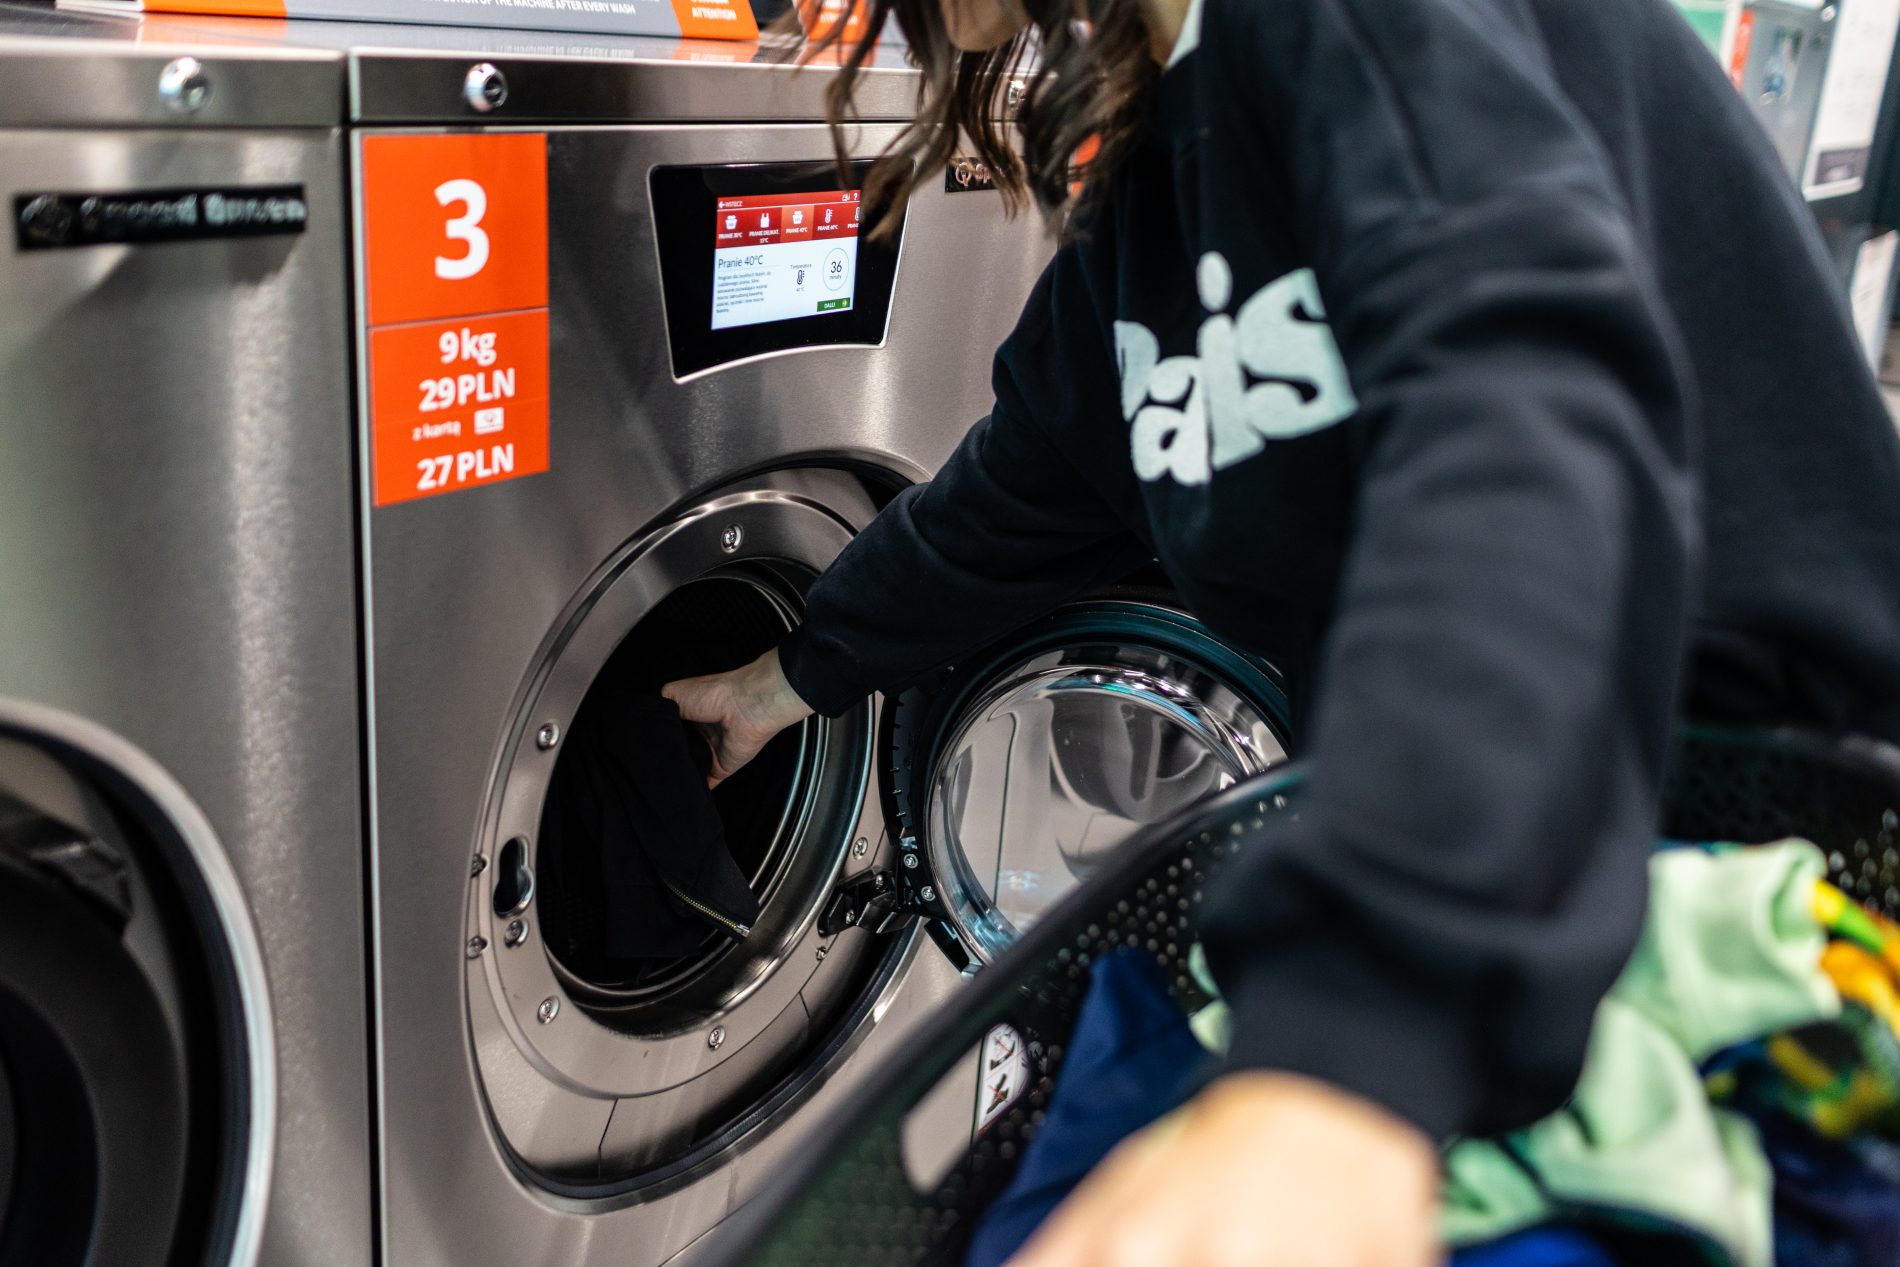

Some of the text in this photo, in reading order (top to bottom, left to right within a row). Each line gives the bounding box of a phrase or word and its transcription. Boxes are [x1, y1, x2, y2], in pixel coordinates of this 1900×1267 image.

[556, 1, 584, 11] AFTER
[584, 2, 610, 13] EVERY
[611, 4, 636, 14] WASH
[434, 179, 490, 280] 3
[718, 257, 743, 268] Pranie
[830, 260, 843, 273] 36
